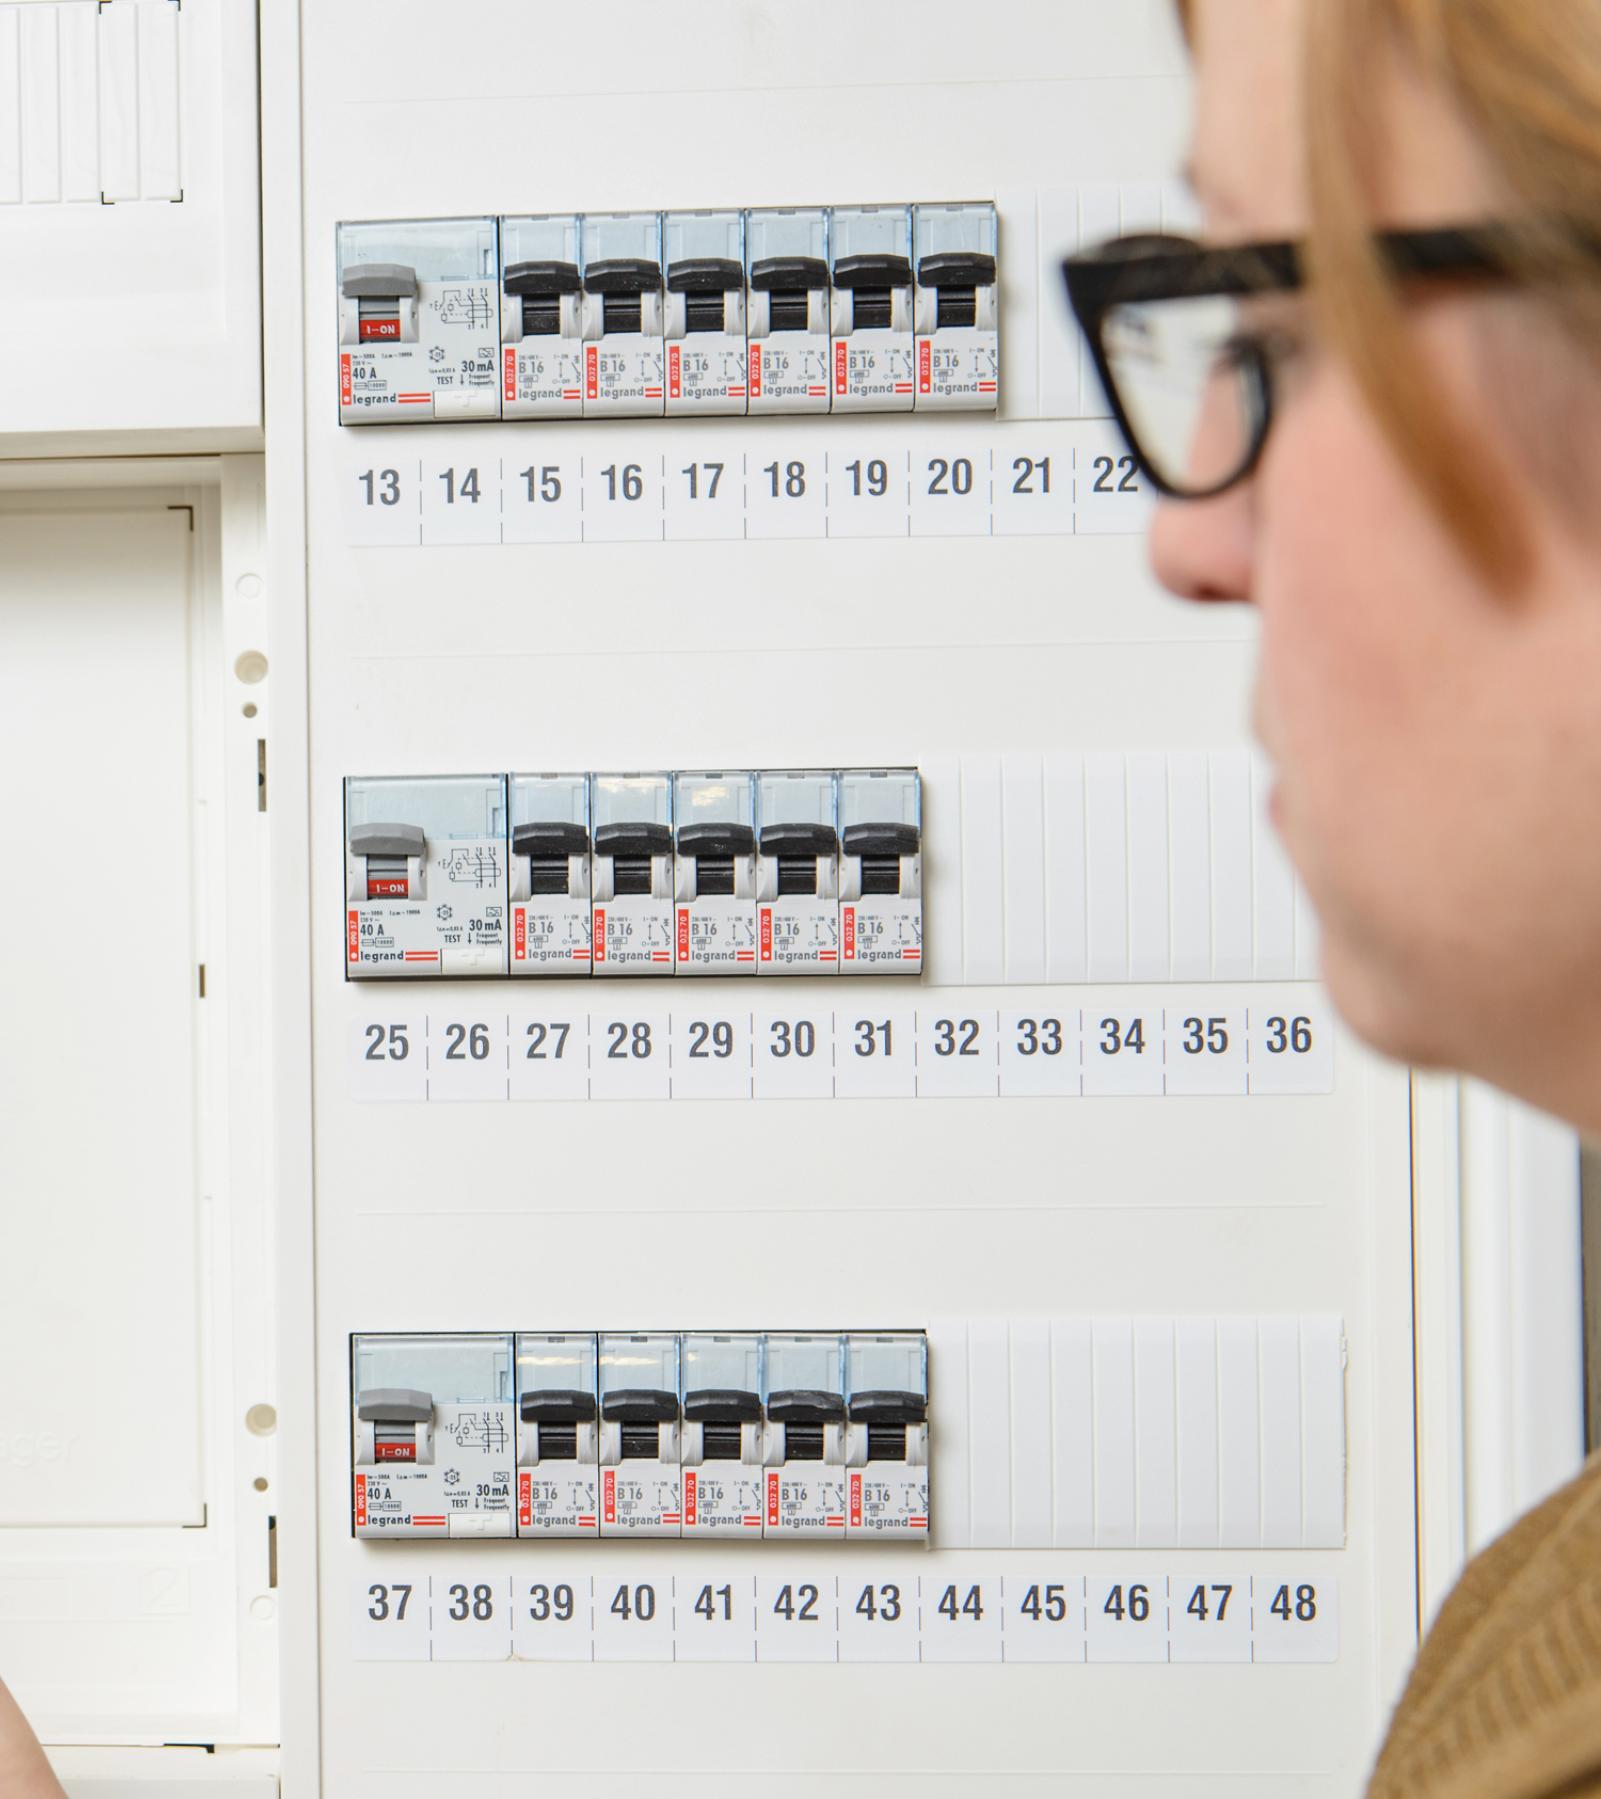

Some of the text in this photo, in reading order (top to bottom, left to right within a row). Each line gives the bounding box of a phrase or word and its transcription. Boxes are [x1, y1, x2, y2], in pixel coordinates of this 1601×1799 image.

[461, 360, 495, 372] 30 mA
[519, 361, 544, 373] B 16
[764, 357, 789, 369] B 16
[353, 368, 377, 380] 40 A
[437, 376, 453, 385] TEST
[519, 388, 562, 400] legrand
[764, 384, 807, 397] legrand
[353, 394, 397, 407] legrand
[359, 456, 1138, 506] 13 14 15 16 17 18 19 20 21 22
[360, 925, 385, 936] 40 A
[469, 920, 502, 932] 30 mA
[529, 922, 554, 934] B 16
[775, 924, 800, 936] B 16
[445, 935, 461, 943] TEST
[360, 951, 404, 963] legrand
[529, 949, 571, 961] legrand
[775, 950, 817, 963] legrand
[365, 1017, 1312, 1060] 25 26 27 28 29 30 31 32 33 34 35 36
[368, 1488, 391, 1500] 40 A
[476, 1485, 509, 1497] 30 mA
[532, 1488, 557, 1500] B 16
[782, 1489, 807, 1500] B 16
[452, 1500, 468, 1508] TEST
[368, 1514, 411, 1527] legrand
[532, 1514, 576, 1527] legrand
[782, 1515, 825, 1528] legrand
[368, 1584, 1317, 1621] 37 38 39 40 41 42 43 44 45 46 47 48
